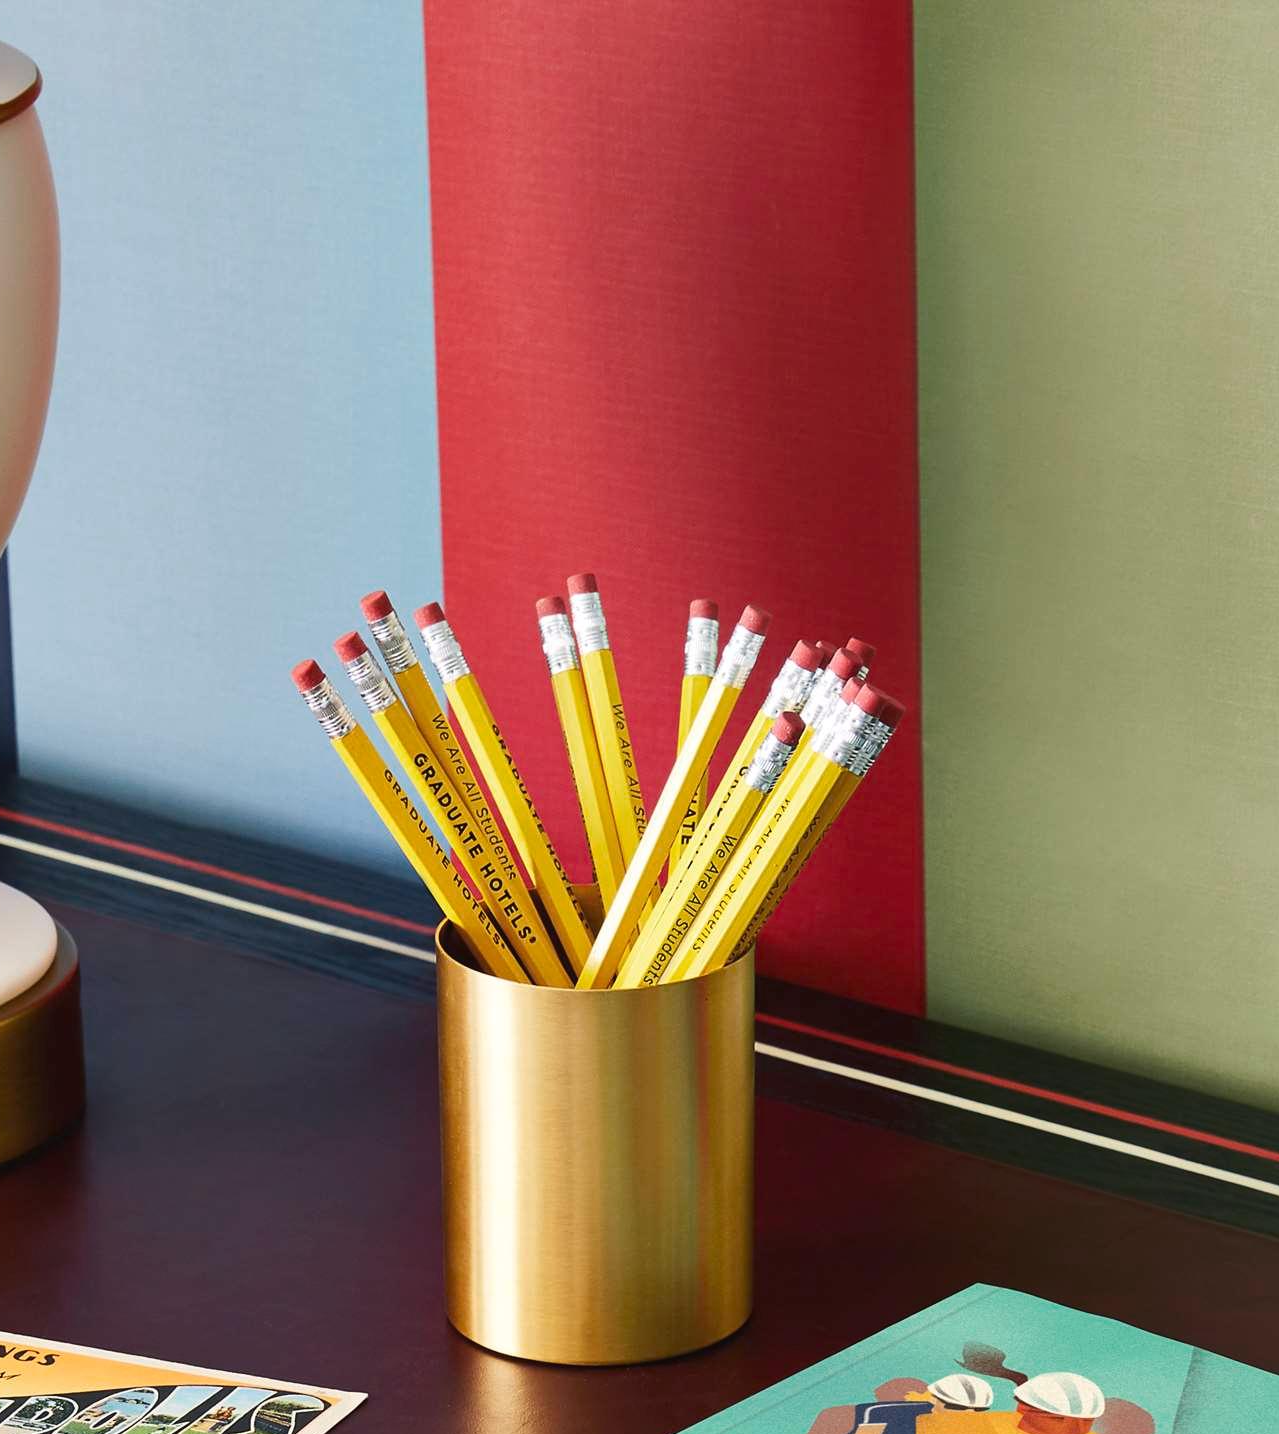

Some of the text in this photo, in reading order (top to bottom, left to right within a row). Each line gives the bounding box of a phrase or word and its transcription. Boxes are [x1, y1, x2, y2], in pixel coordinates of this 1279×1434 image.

[612, 703, 625, 730] We
[618, 736, 633, 769] Are
[383, 768, 451, 870] GRADUATE
[413, 752, 484, 859] GRADUATE
[431, 712, 517, 881] We Are All Students
[626, 774, 641, 801] All
[643, 834, 737, 986] We Are All Students
